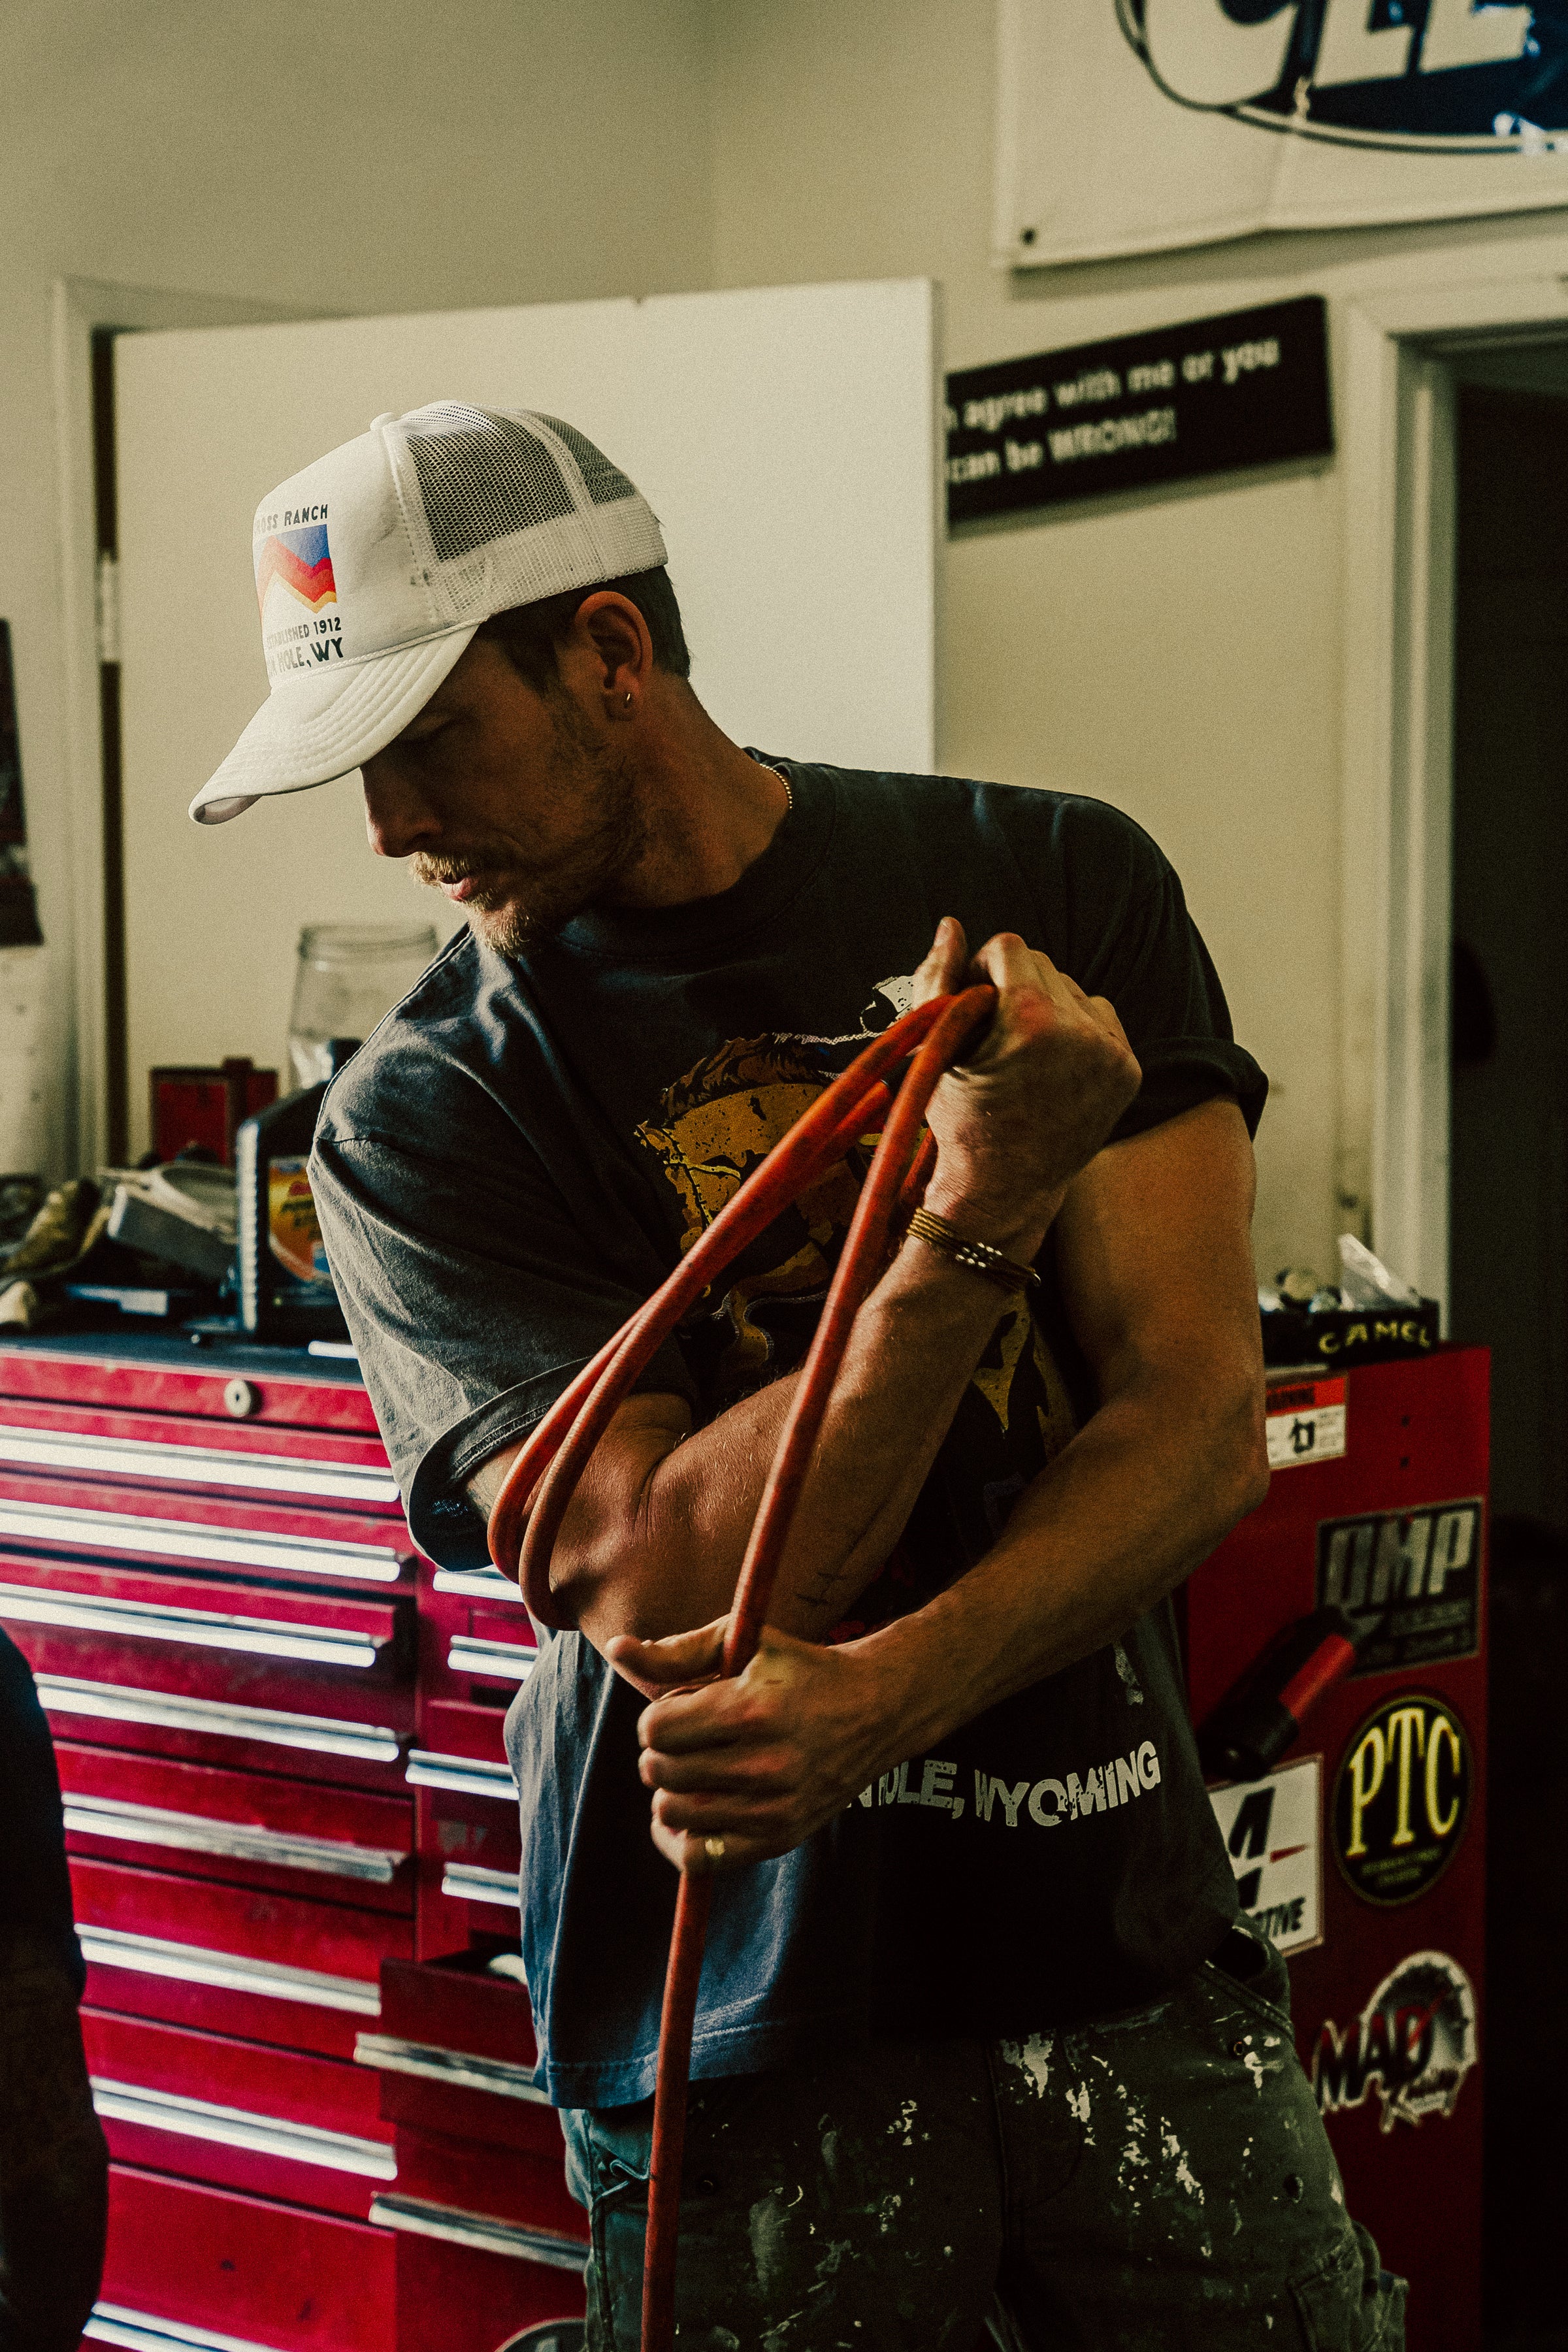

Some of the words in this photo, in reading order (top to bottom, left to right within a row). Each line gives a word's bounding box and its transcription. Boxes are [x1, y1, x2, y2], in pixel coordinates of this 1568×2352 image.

[963, 386, 1047, 433] agree
[1053, 366, 1121, 408] with
[1126, 361, 1175, 393] me
[1181, 350, 1214, 384] or
[1222, 336, 1281, 385] you
[1005, 437, 1043, 472] be
[284, 504, 328, 526] RANCH
[314, 617, 342, 635] 1912
[310, 637, 344, 662] WY
[1318, 1318, 1431, 1355] CAMEL
[974, 1740, 1162, 1827] WYOMING
[1346, 1706, 1462, 1859] PTC
[1316, 2004, 1433, 2110] MAD
